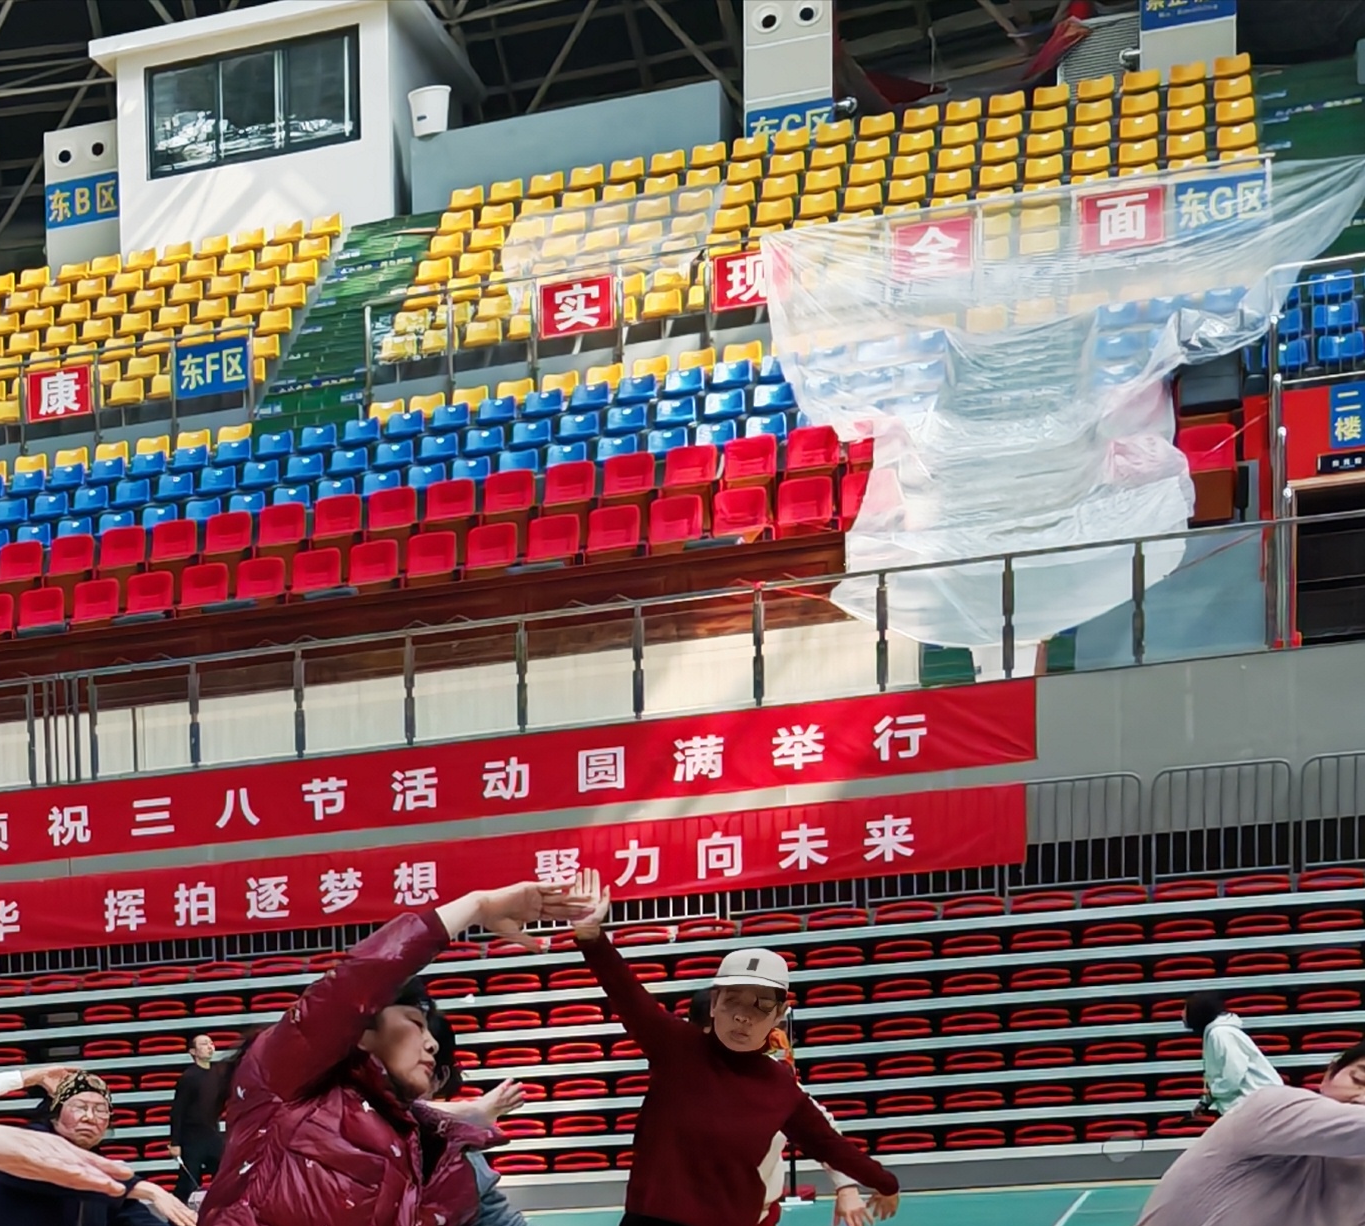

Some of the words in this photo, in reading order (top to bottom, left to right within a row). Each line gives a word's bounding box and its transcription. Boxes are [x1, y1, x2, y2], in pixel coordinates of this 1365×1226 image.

[49, 179, 117, 222] 东B区
[1096, 193, 1150, 247] 面
[1179, 180, 1265, 229] 东G区
[908, 226, 961, 276] 全
[726, 256, 768, 302] 现
[554, 283, 601, 331] 实
[180, 347, 246, 391] 东F区
[39, 371, 80, 416] 康
[1334, 391, 1362, 442] 二楼
[105, 861, 438, 932] 挥拍逐梦想
[535, 815, 914, 890] 聚力向未来
